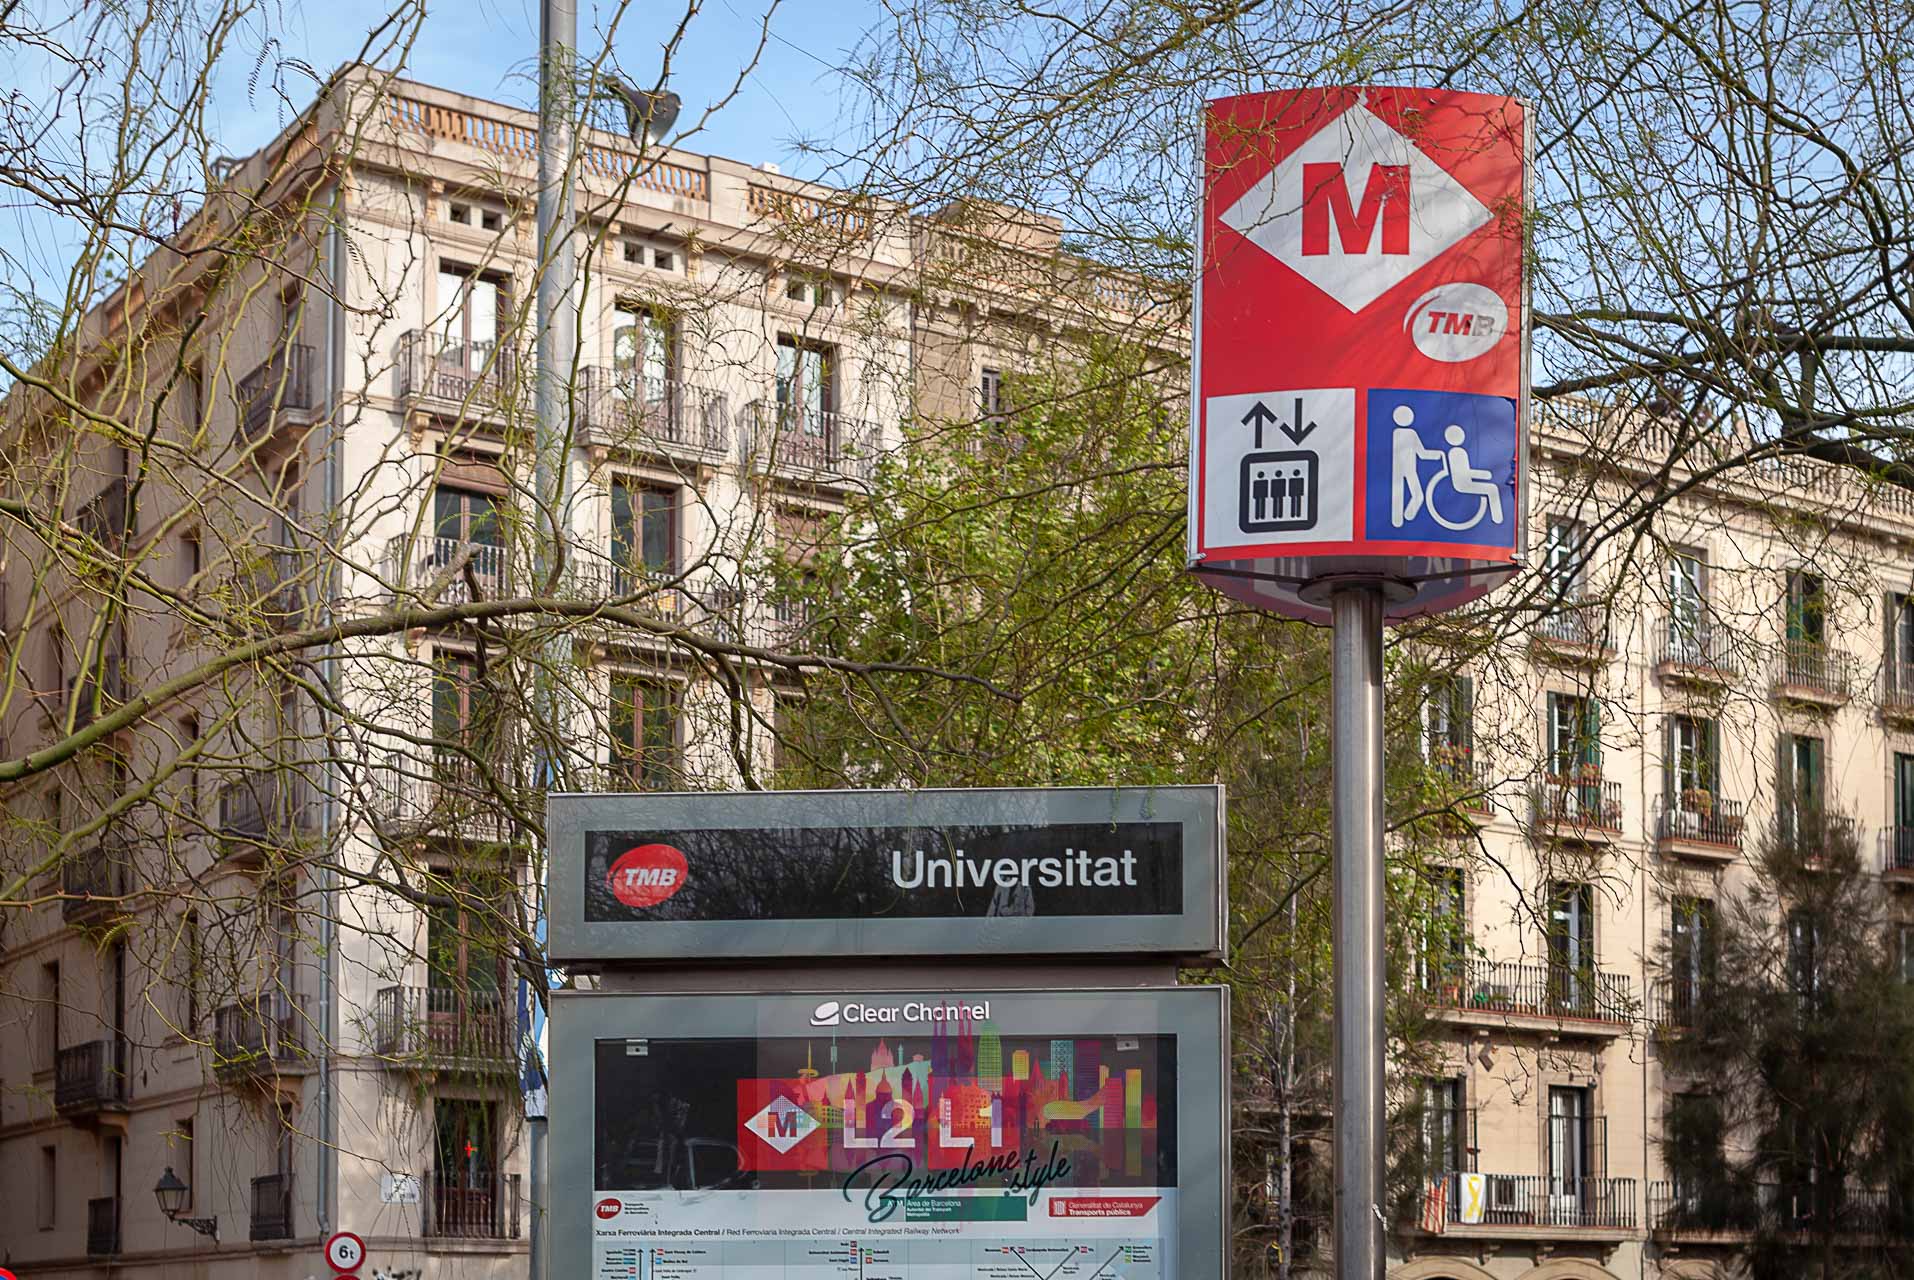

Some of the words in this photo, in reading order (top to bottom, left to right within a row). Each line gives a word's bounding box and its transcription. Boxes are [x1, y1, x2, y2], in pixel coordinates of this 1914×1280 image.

[1302, 162, 1410, 256] M
[1428, 311, 1495, 336] TMB
[625, 868, 677, 887] TMB
[892, 848, 1137, 888] Universitat
[843, 1003, 899, 1022] Clear
[903, 1001, 990, 1021] Channel
[768, 1111, 798, 1138] M
[843, 1099, 916, 1149] L2
[1069, 1201, 1101, 1209] Generalitat
[1112, 1201, 1143, 1210] Catalunya
[1069, 1209, 1105, 1217] Transports
[595, 1229, 616, 1237] Xarxa
[658, 1229, 692, 1238] Integrada
[727, 1228, 740, 1236] Red
[779, 1228, 811, 1237] Integrada
[812, 1228, 836, 1236] Central
[842, 1227, 867, 1235] Central
[868, 1227, 902, 1237] Integrated
[904, 1227, 929, 1236] Railway
[931, 1227, 960, 1235] Network
